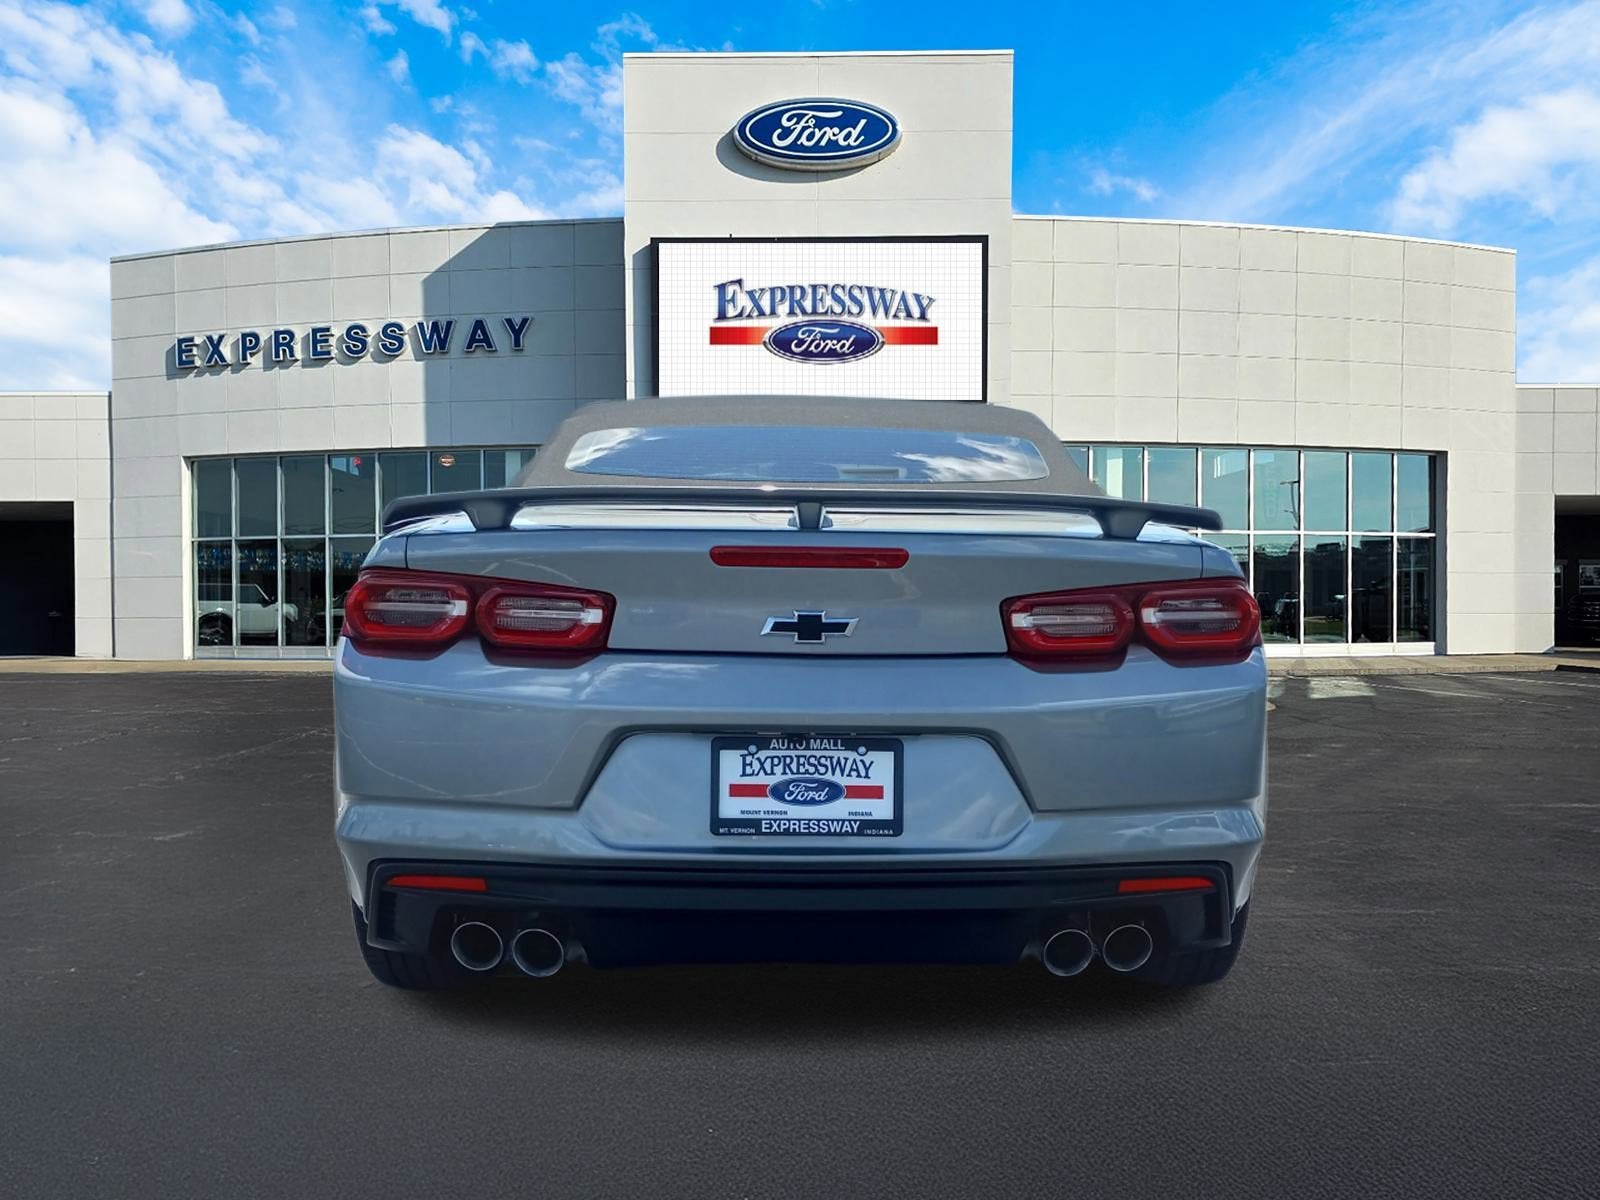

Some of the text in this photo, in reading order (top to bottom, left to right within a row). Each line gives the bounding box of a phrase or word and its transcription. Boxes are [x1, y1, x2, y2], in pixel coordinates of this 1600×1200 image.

[772, 109, 867, 148] Ford
[175, 316, 531, 368] EXPRESSWAY
[791, 326, 855, 353] Ford
[809, 738, 845, 750] MALL
[784, 782, 829, 800] Ford
[761, 820, 860, 833] EXPRESSWAY
